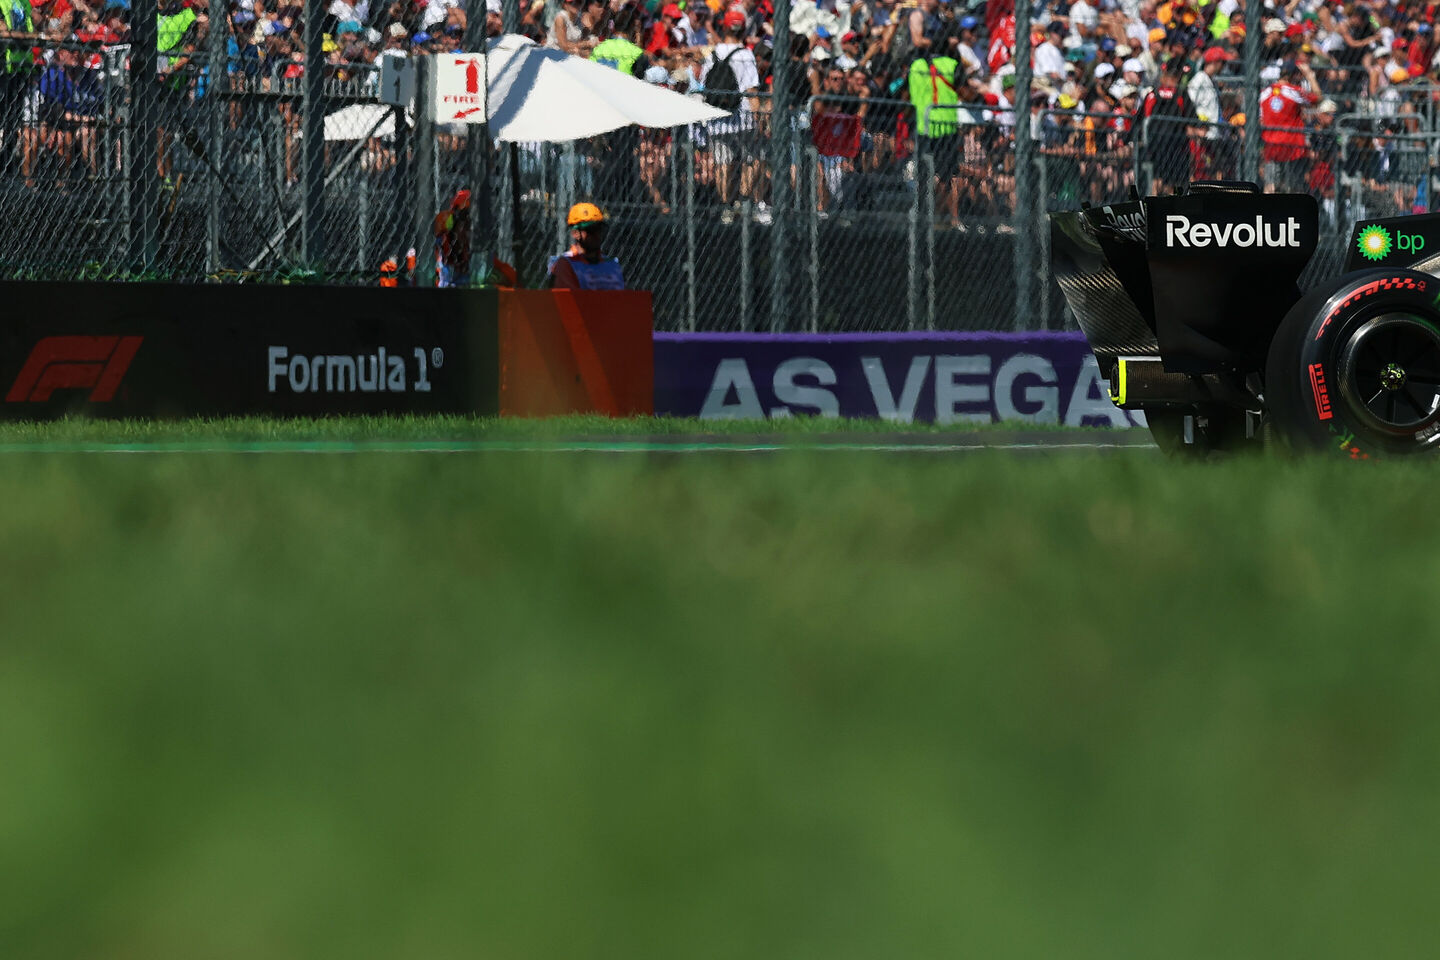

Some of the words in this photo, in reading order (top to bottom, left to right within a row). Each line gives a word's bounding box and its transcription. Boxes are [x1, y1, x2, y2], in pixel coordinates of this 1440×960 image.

[1165, 214, 1301, 248] Revolut
[1396, 228, 1425, 254] bp
[267, 345, 406, 392] Formula
[700, 357, 841, 420] AS
[861, 352, 1149, 428] VEGA
[1307, 363, 1335, 422] PIRELLI
